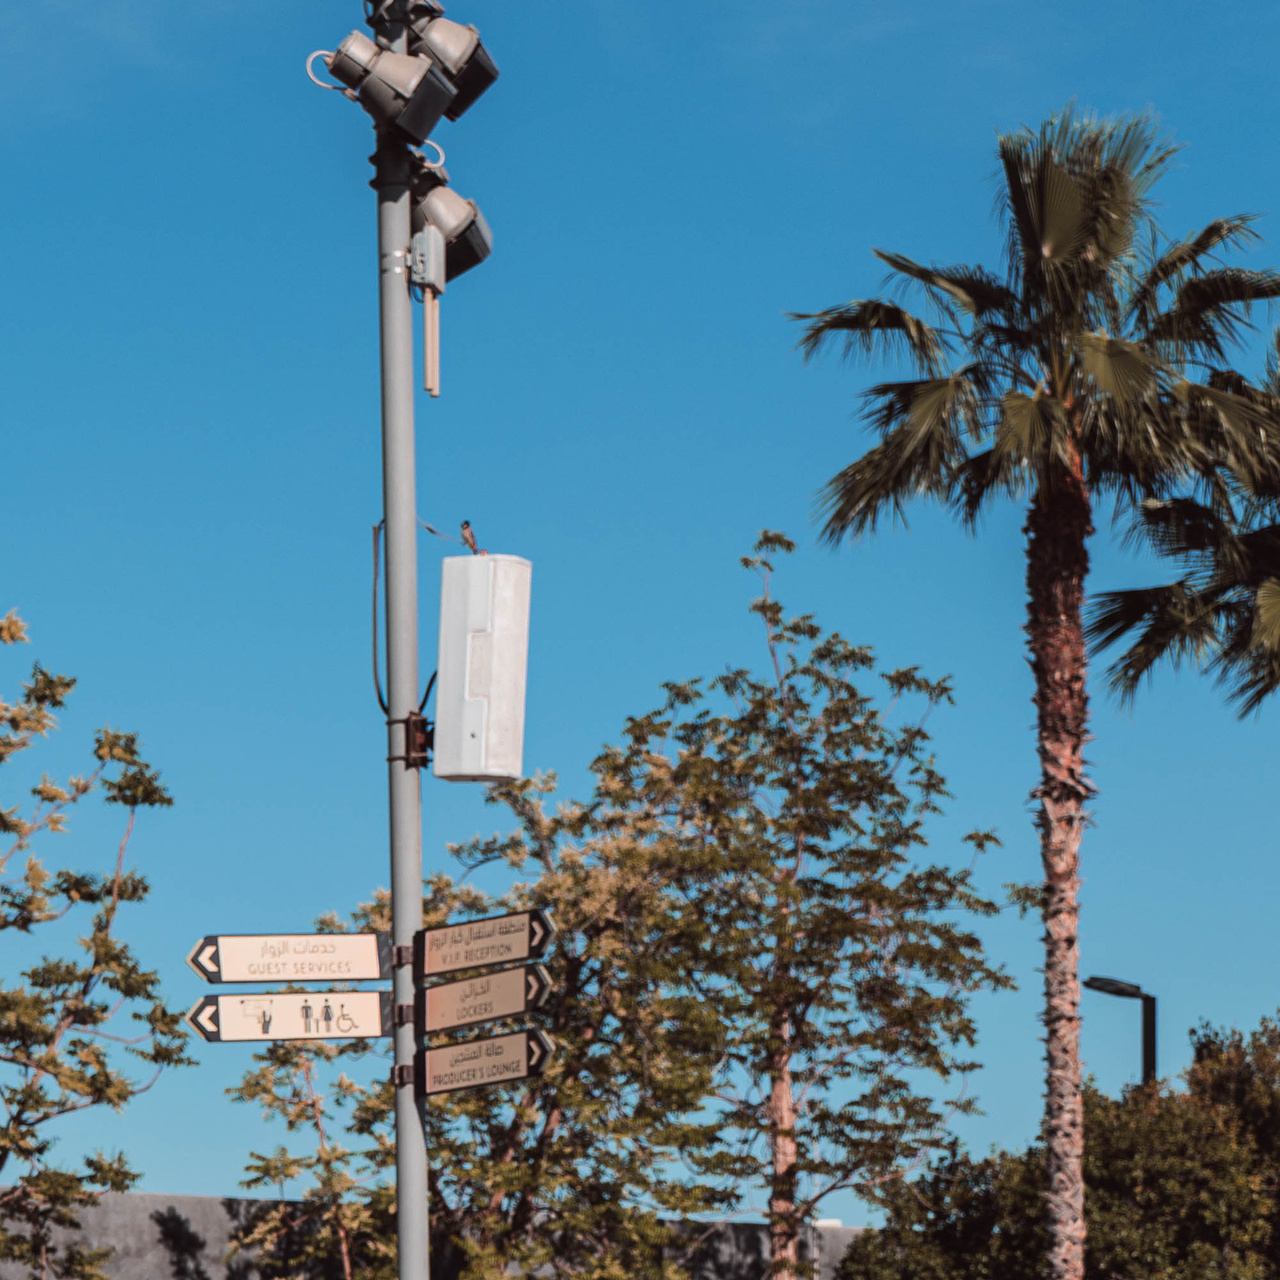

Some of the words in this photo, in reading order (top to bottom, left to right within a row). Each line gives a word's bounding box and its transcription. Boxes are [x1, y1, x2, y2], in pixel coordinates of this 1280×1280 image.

[464, 944, 512, 961] RECEPTION
[248, 962, 287, 975] GUEST
[293, 961, 352, 975] SERVICES
[456, 1002, 494, 1020] LOCKERS
[486, 1059, 521, 1078] LOUNGE
